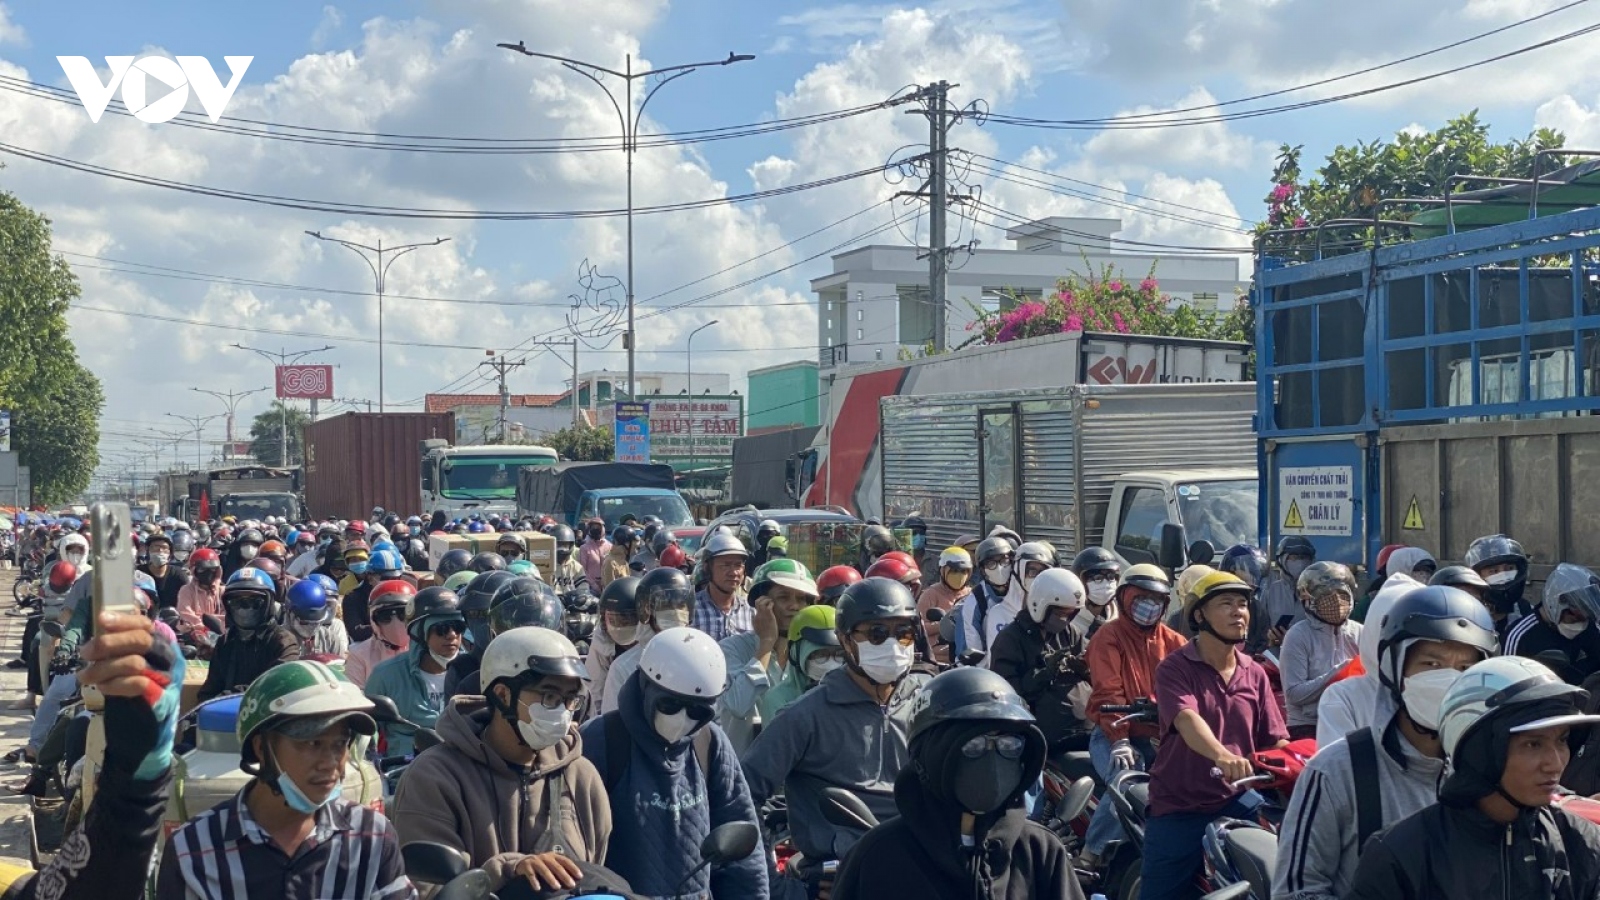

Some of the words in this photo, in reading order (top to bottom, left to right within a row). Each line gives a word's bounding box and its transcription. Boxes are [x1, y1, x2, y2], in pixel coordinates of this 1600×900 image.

[284, 368, 326, 394] GO!
[702, 414, 738, 435] TÂM
[1297, 471, 1320, 486] CHUYỂN
[1308, 503, 1329, 520] CHÂN
[1330, 502, 1341, 520] LÝ
